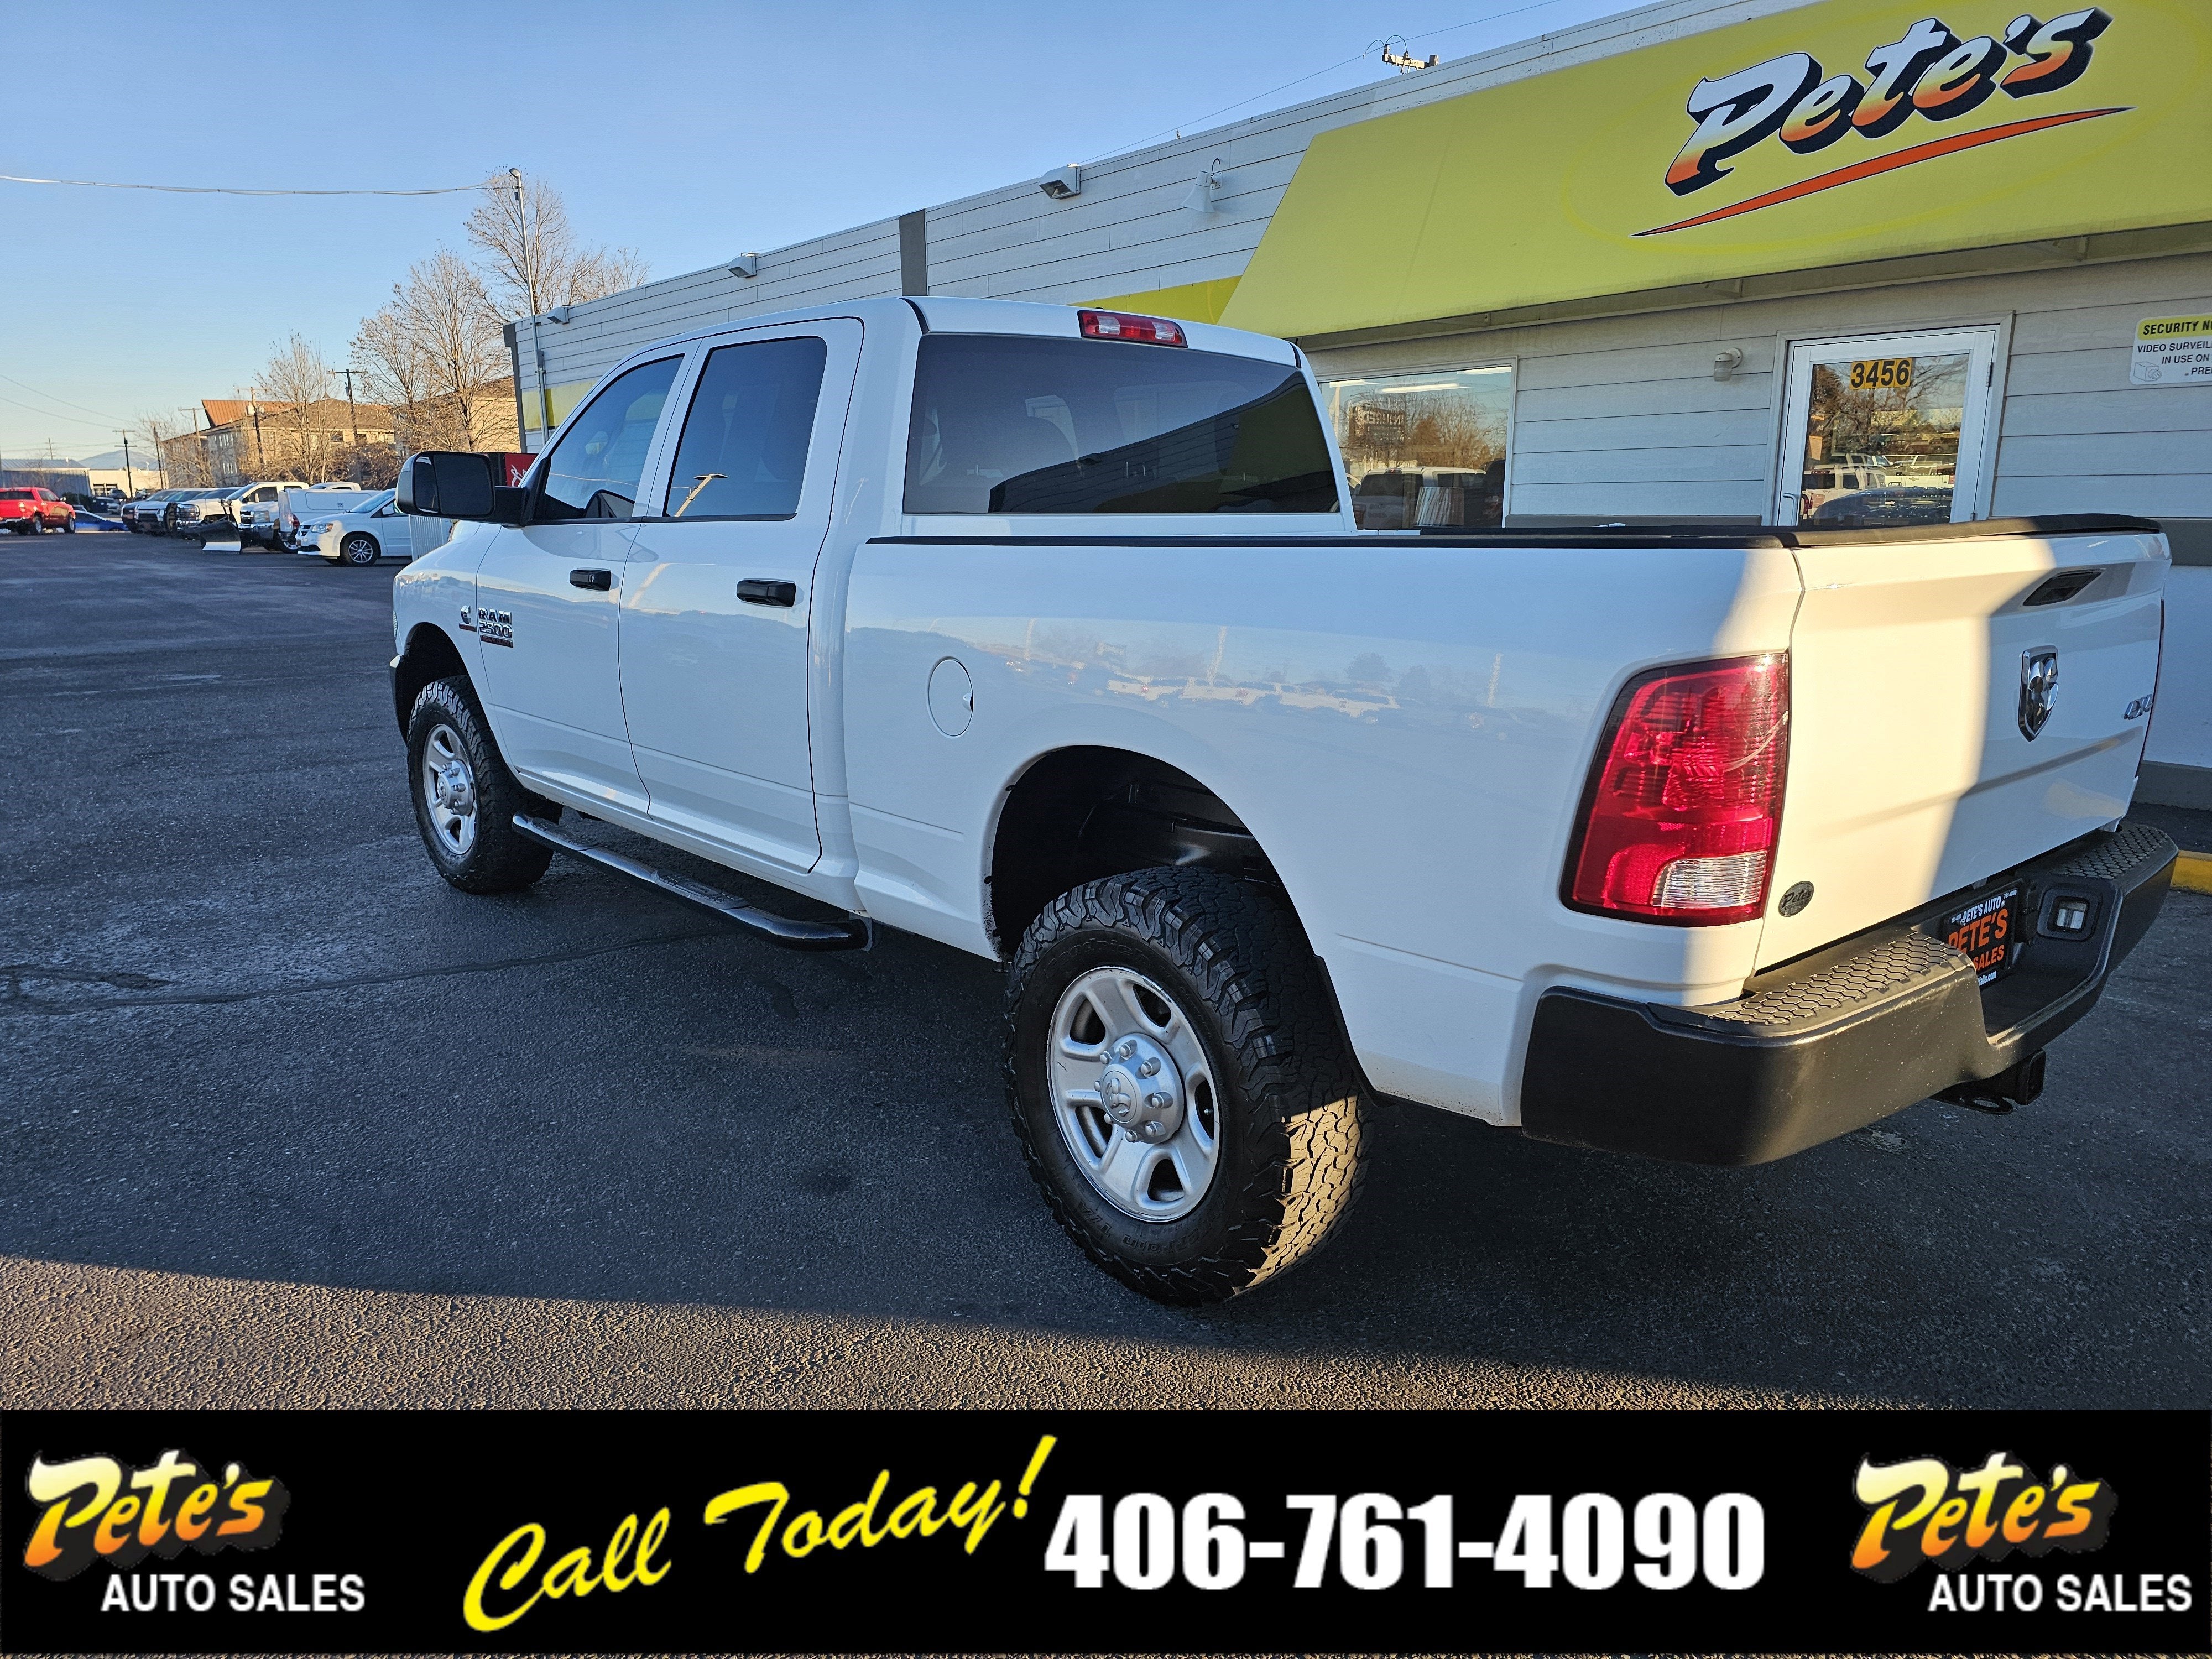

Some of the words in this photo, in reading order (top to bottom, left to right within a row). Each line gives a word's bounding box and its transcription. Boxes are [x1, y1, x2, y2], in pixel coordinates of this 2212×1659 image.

[1665, 7, 2114, 196] Pete's
[2143, 321, 2199, 335] SECURITY
[2203, 320, 2212, 331] N
[2137, 344, 2167, 353] VIDEO
[2169, 341, 2212, 351] SURVEIL
[2162, 356, 2172, 364] IN
[2174, 355, 2193, 364] USE
[2195, 354, 2210, 362] ON
[1851, 359, 1910, 388] 3456
[2191, 367, 2212, 375] PRE
[478, 607, 512, 625] RAM
[479, 620, 513, 639] 2500
[1963, 903, 1983, 923] PETE'S
[1983, 895, 2001, 915] AUTO
[1948, 909, 2008, 954] PETE'S
[1973, 945, 2005, 971] SALES
